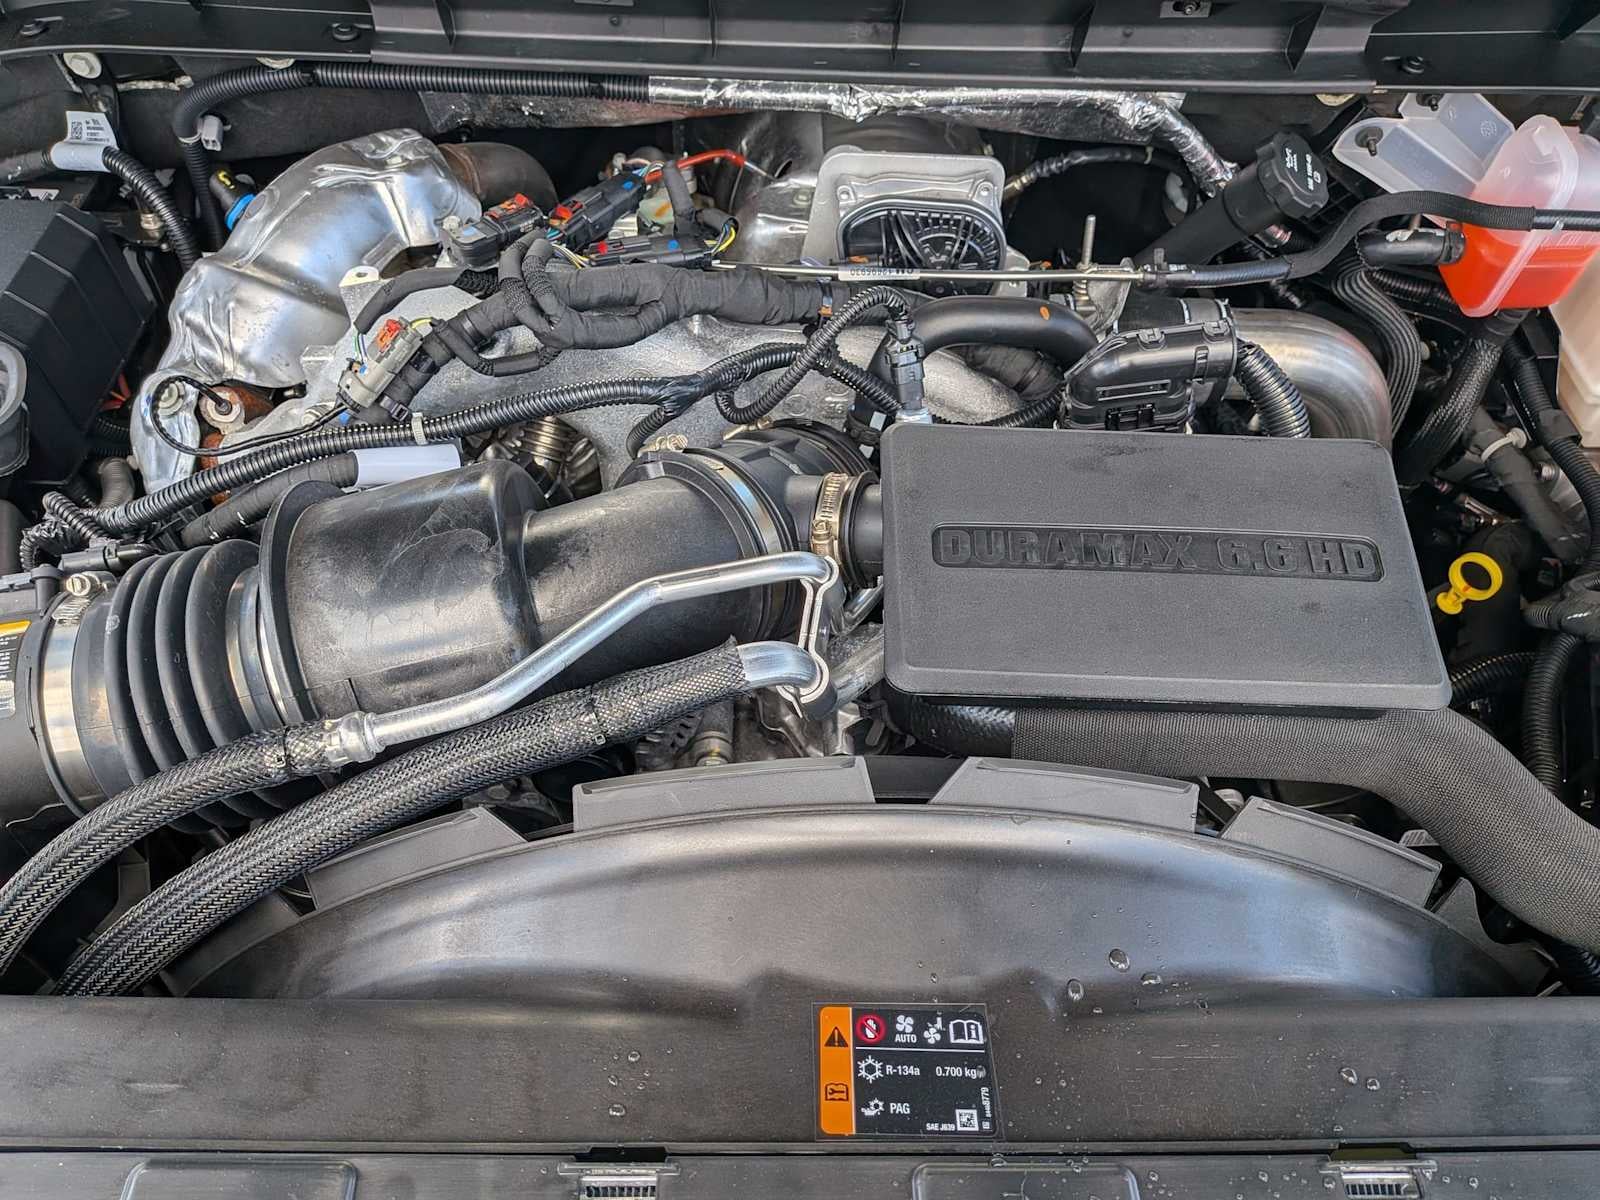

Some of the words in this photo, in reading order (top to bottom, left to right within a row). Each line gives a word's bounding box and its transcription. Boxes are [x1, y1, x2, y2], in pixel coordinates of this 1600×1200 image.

[940, 529, 1198, 569] DURAMAX
[1216, 537, 1299, 572] 6.6
[1306, 540, 1377, 574] HD
[894, 1034, 917, 1043] AUTO
[885, 1064, 921, 1076] R-134a
[935, 1066, 963, 1077] 0.700
[964, 1067, 977, 1080] kg
[889, 1102, 911, 1115] PAG
[926, 1122, 940, 1131] SAE
